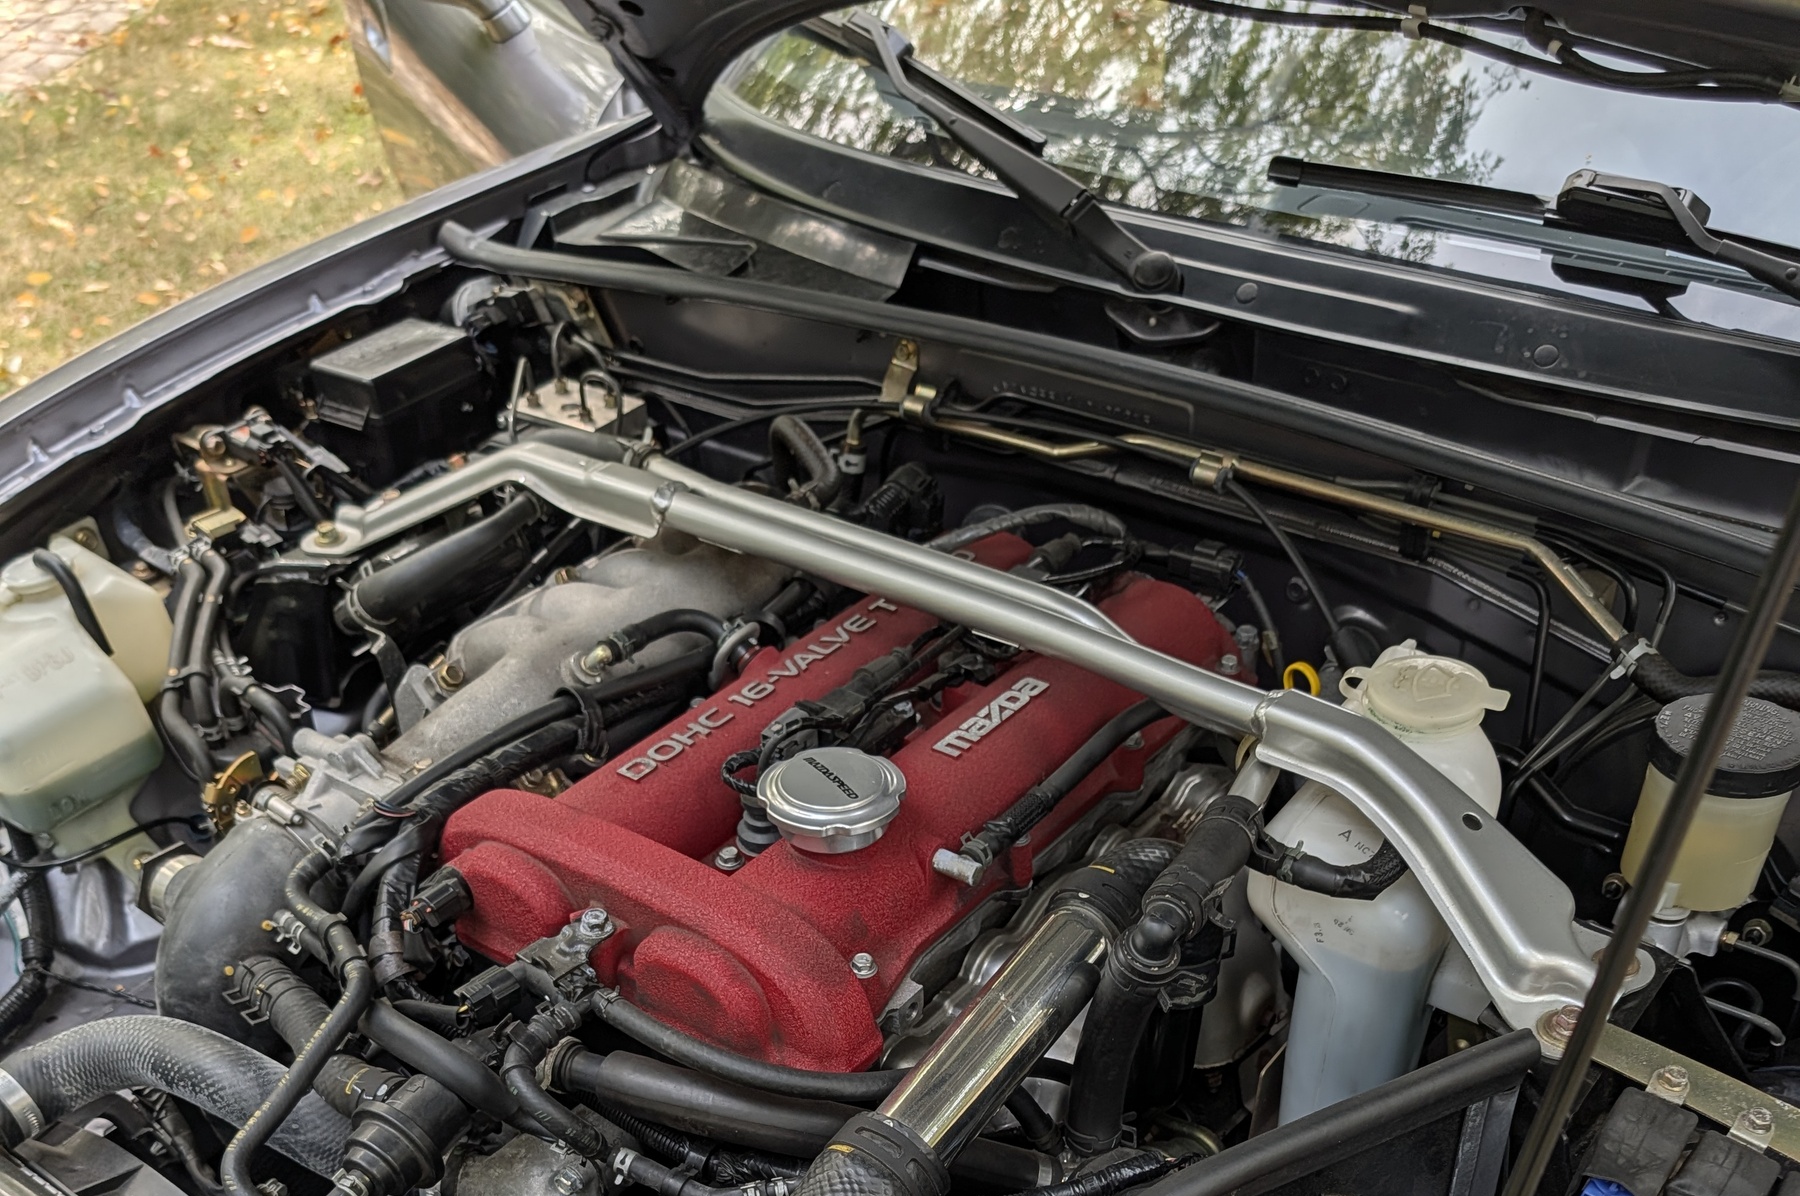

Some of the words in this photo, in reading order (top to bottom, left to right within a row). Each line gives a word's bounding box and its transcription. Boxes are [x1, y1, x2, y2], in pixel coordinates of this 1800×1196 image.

[617, 707, 734, 781] DOHC
[728, 614, 877, 706] 16-VALVE
[802, 756, 859, 800] MAZDASPEED
[1338, 829, 1352, 842] A
